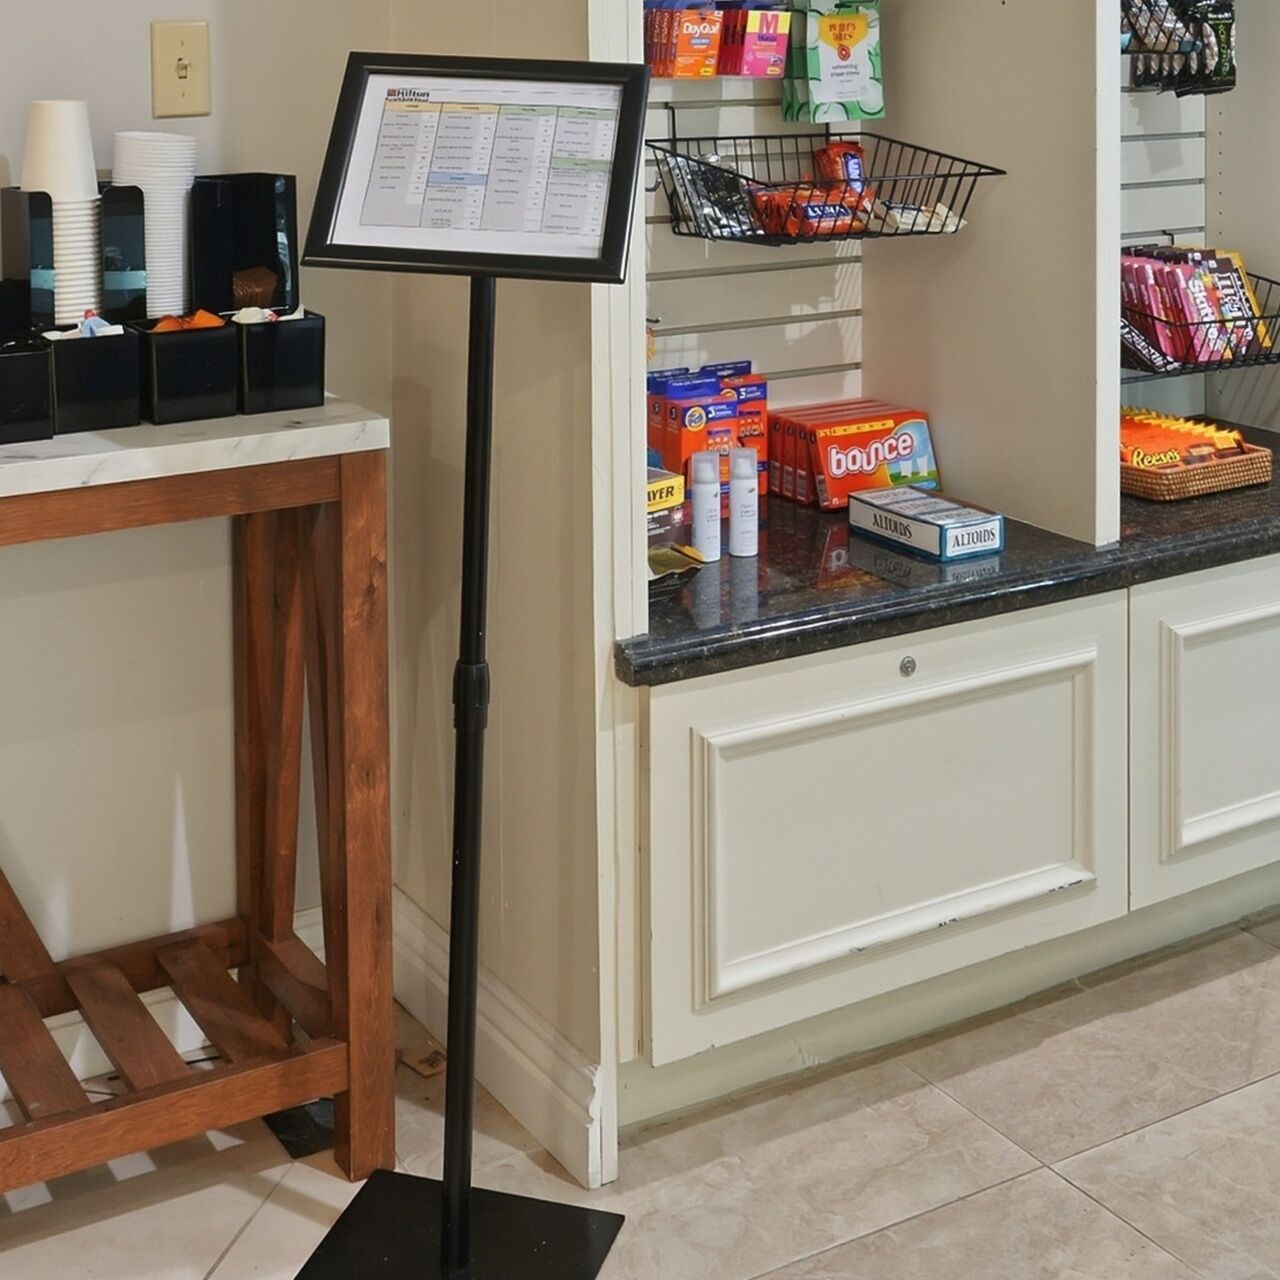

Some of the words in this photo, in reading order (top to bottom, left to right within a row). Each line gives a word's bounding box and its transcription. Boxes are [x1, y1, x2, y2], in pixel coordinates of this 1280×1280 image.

[397, 89, 429, 98] Hilton
[828, 431, 914, 479] bounce
[647, 485, 675, 503] AYER
[871, 512, 913, 540] ALTOIDS
[951, 526, 996, 549] ALTOIDS
